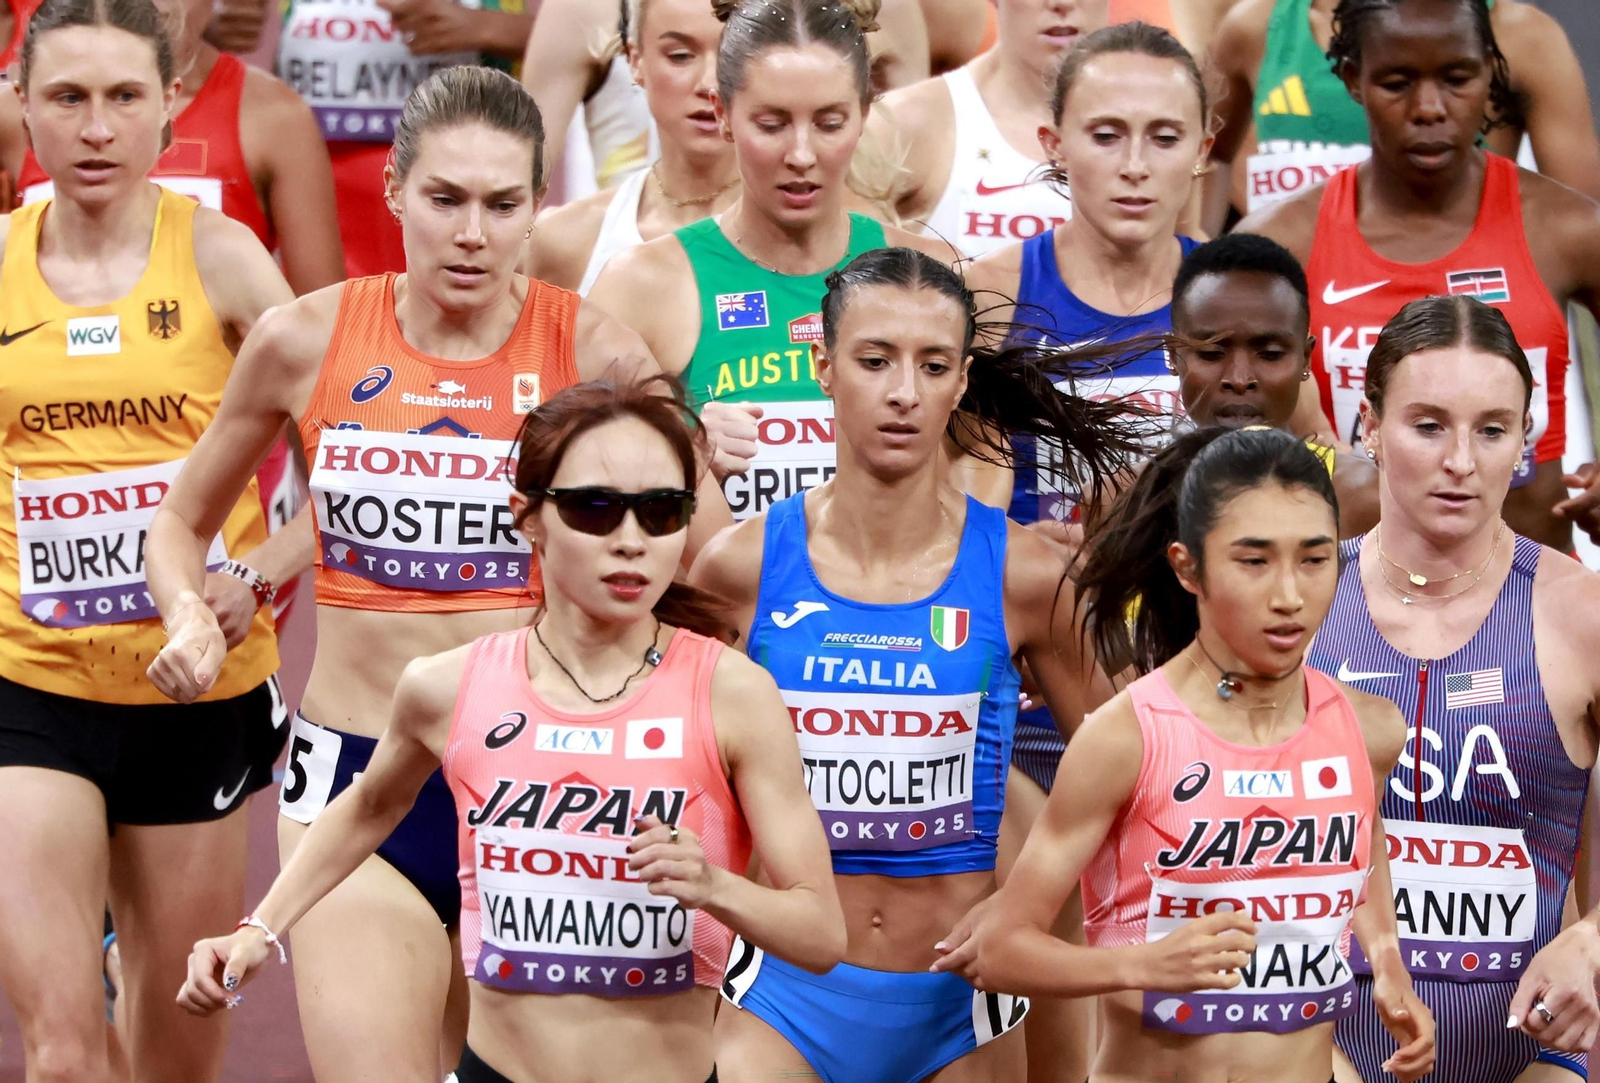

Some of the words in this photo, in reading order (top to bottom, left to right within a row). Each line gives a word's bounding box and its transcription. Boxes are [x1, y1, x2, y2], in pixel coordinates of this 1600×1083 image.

[69, 325, 118, 345] WGV
[20, 393, 188, 433] GERMANY
[401, 392, 493, 411] Staatsloterij
[324, 491, 519, 546] KOSTER
[823, 632, 923, 648] FRECCIAROSSA
[803, 655, 937, 689] ITALIA
[540, 729, 610, 751] ACN
[1228, 773, 1287, 795] ACN
[468, 780, 687, 837] JAPAN
[1156, 814, 1357, 869] JAPAN
[484, 892, 688, 950] YAMAMOTO
